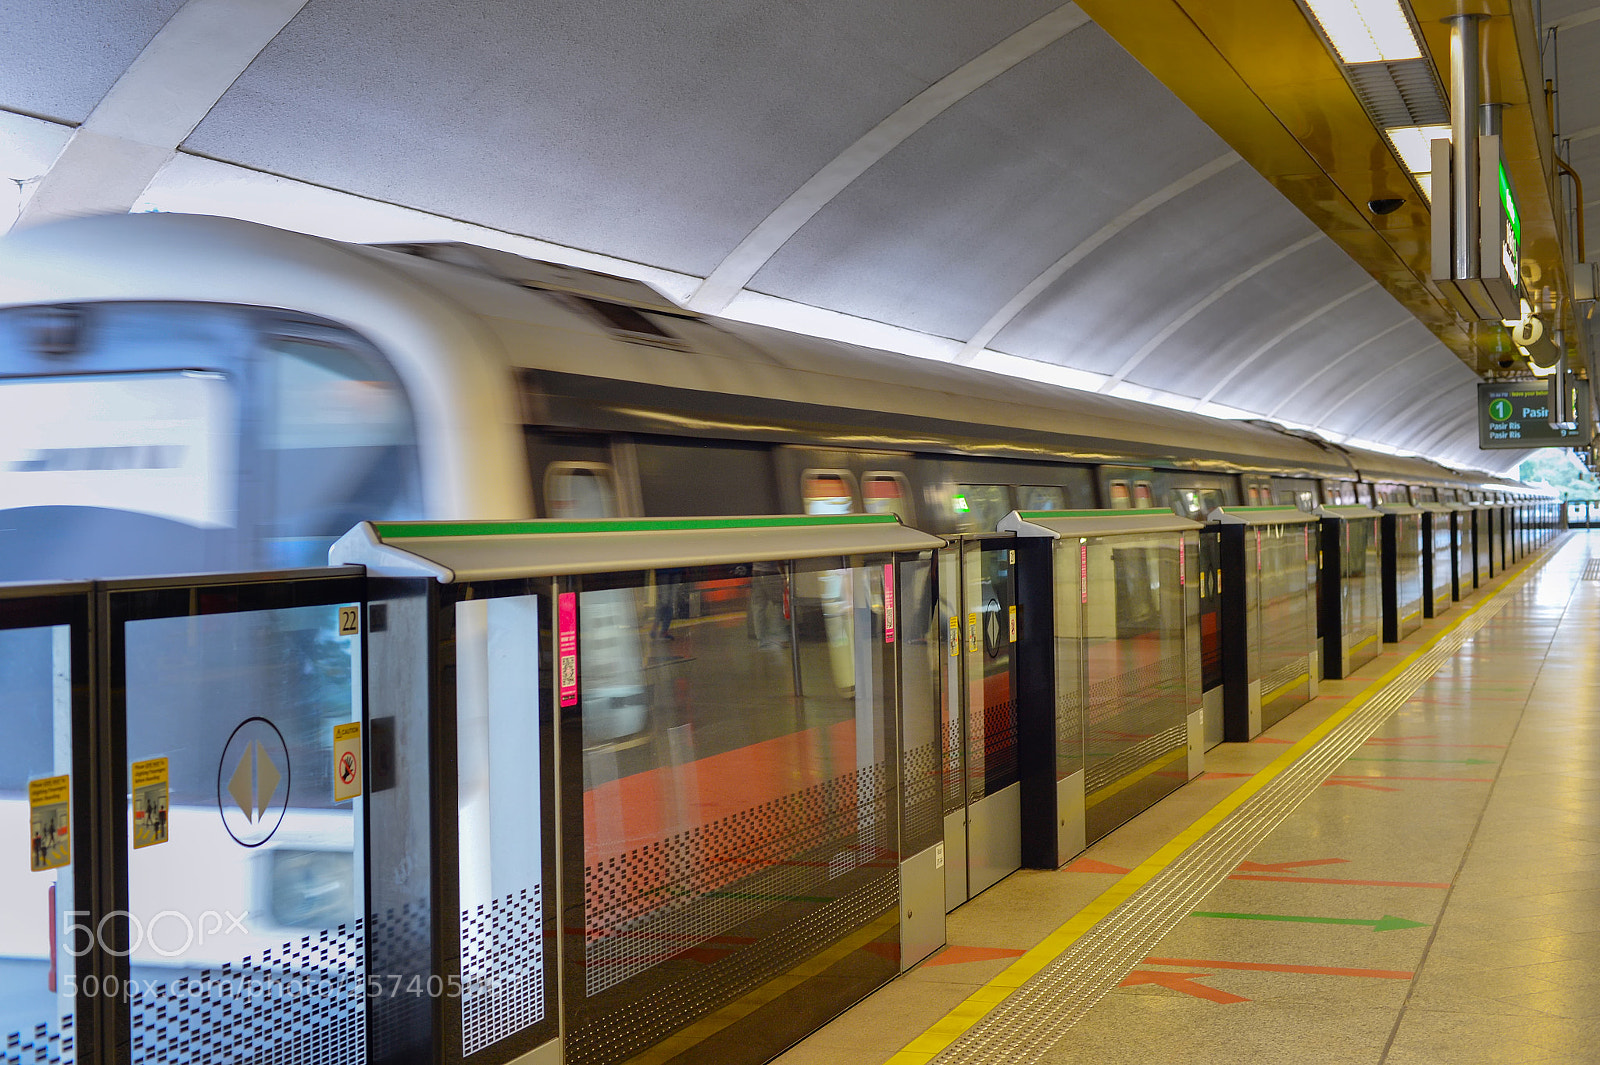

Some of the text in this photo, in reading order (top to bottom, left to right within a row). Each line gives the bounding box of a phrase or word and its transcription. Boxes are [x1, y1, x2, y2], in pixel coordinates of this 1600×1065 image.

[1496, 401, 1549, 418] 1 Pasir
[1489, 422, 1509, 430] Pasir
[1489, 431, 1509, 439] Pasir
[342, 611, 356, 631] 22
